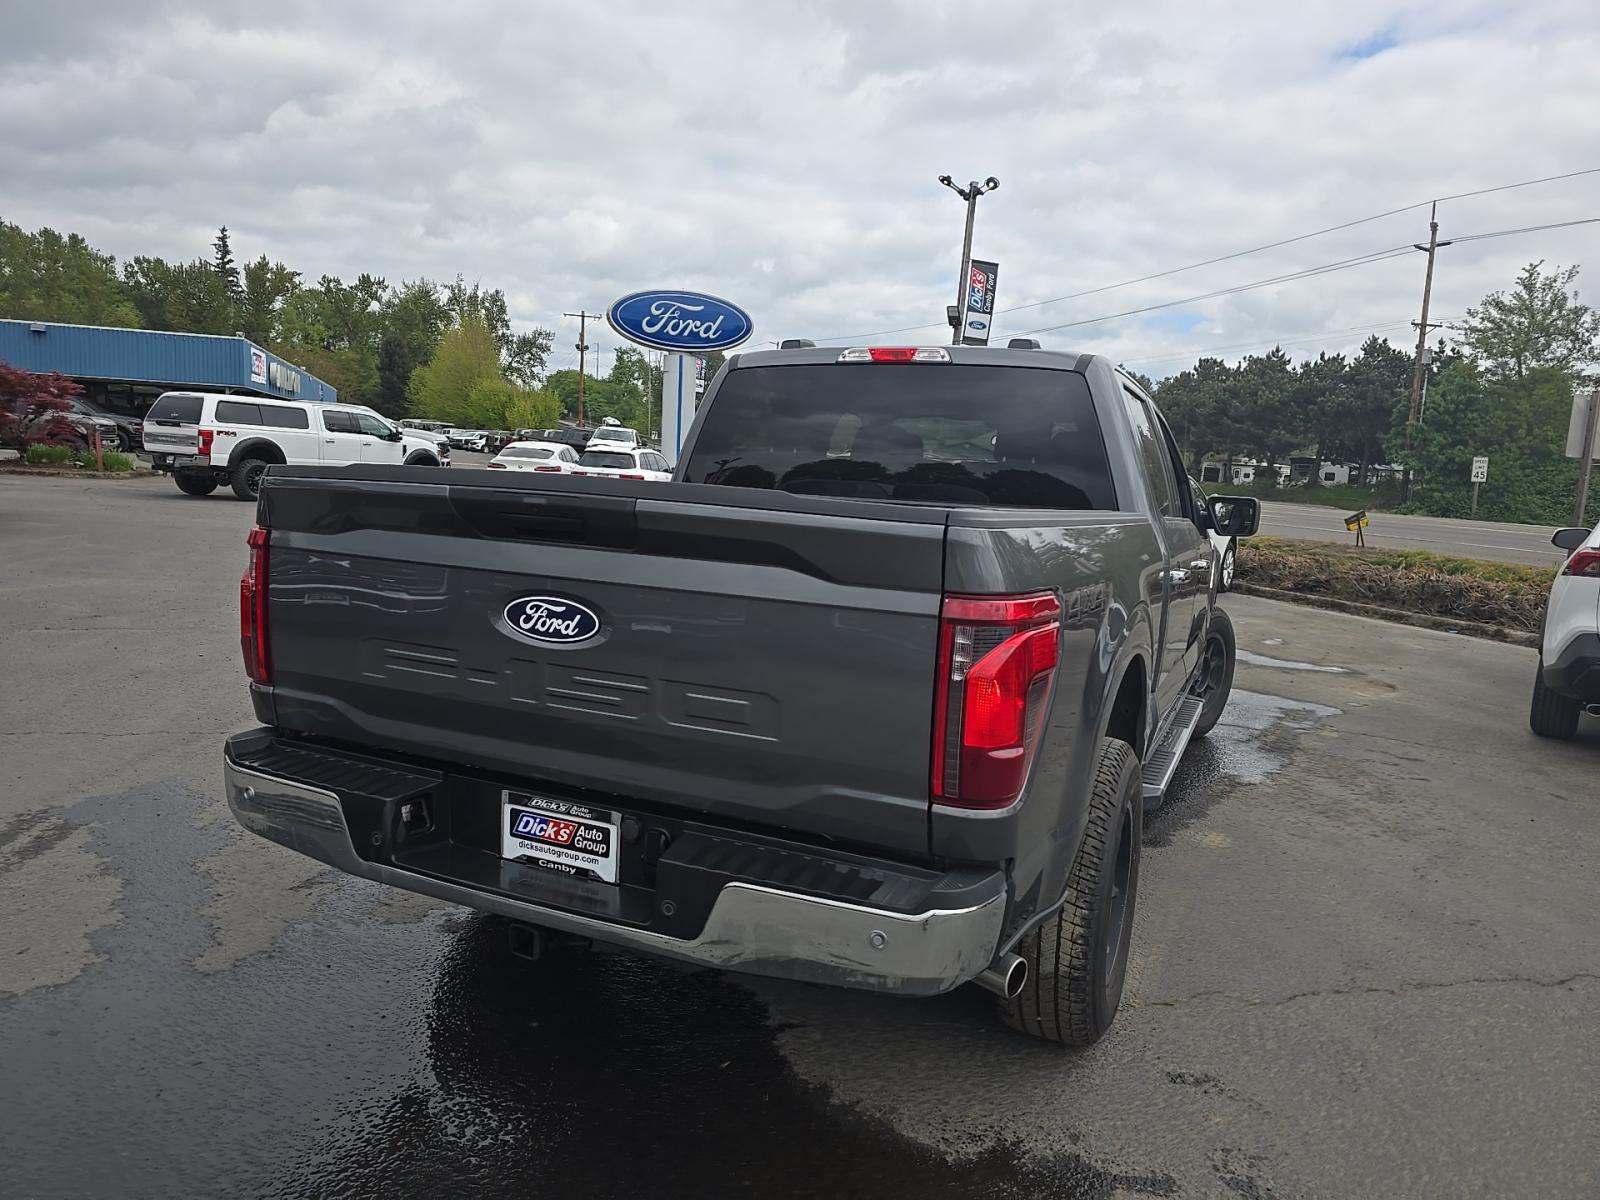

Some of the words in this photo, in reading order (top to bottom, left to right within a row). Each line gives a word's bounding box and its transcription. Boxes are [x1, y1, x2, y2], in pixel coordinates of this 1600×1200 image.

[972, 273, 985, 308] Dick's
[987, 273, 995, 289] Ford
[642, 300, 724, 339] Ford
[1474, 471, 1486, 480] 45
[519, 601, 582, 636] Ford
[530, 798, 567, 813] Dick's
[517, 815, 571, 841] Dick's
[577, 826, 603, 841] Auto
[518, 840, 600, 865] dicksautogroup.com
[574, 836, 607, 854] Group
[538, 860, 577, 875] Canby
